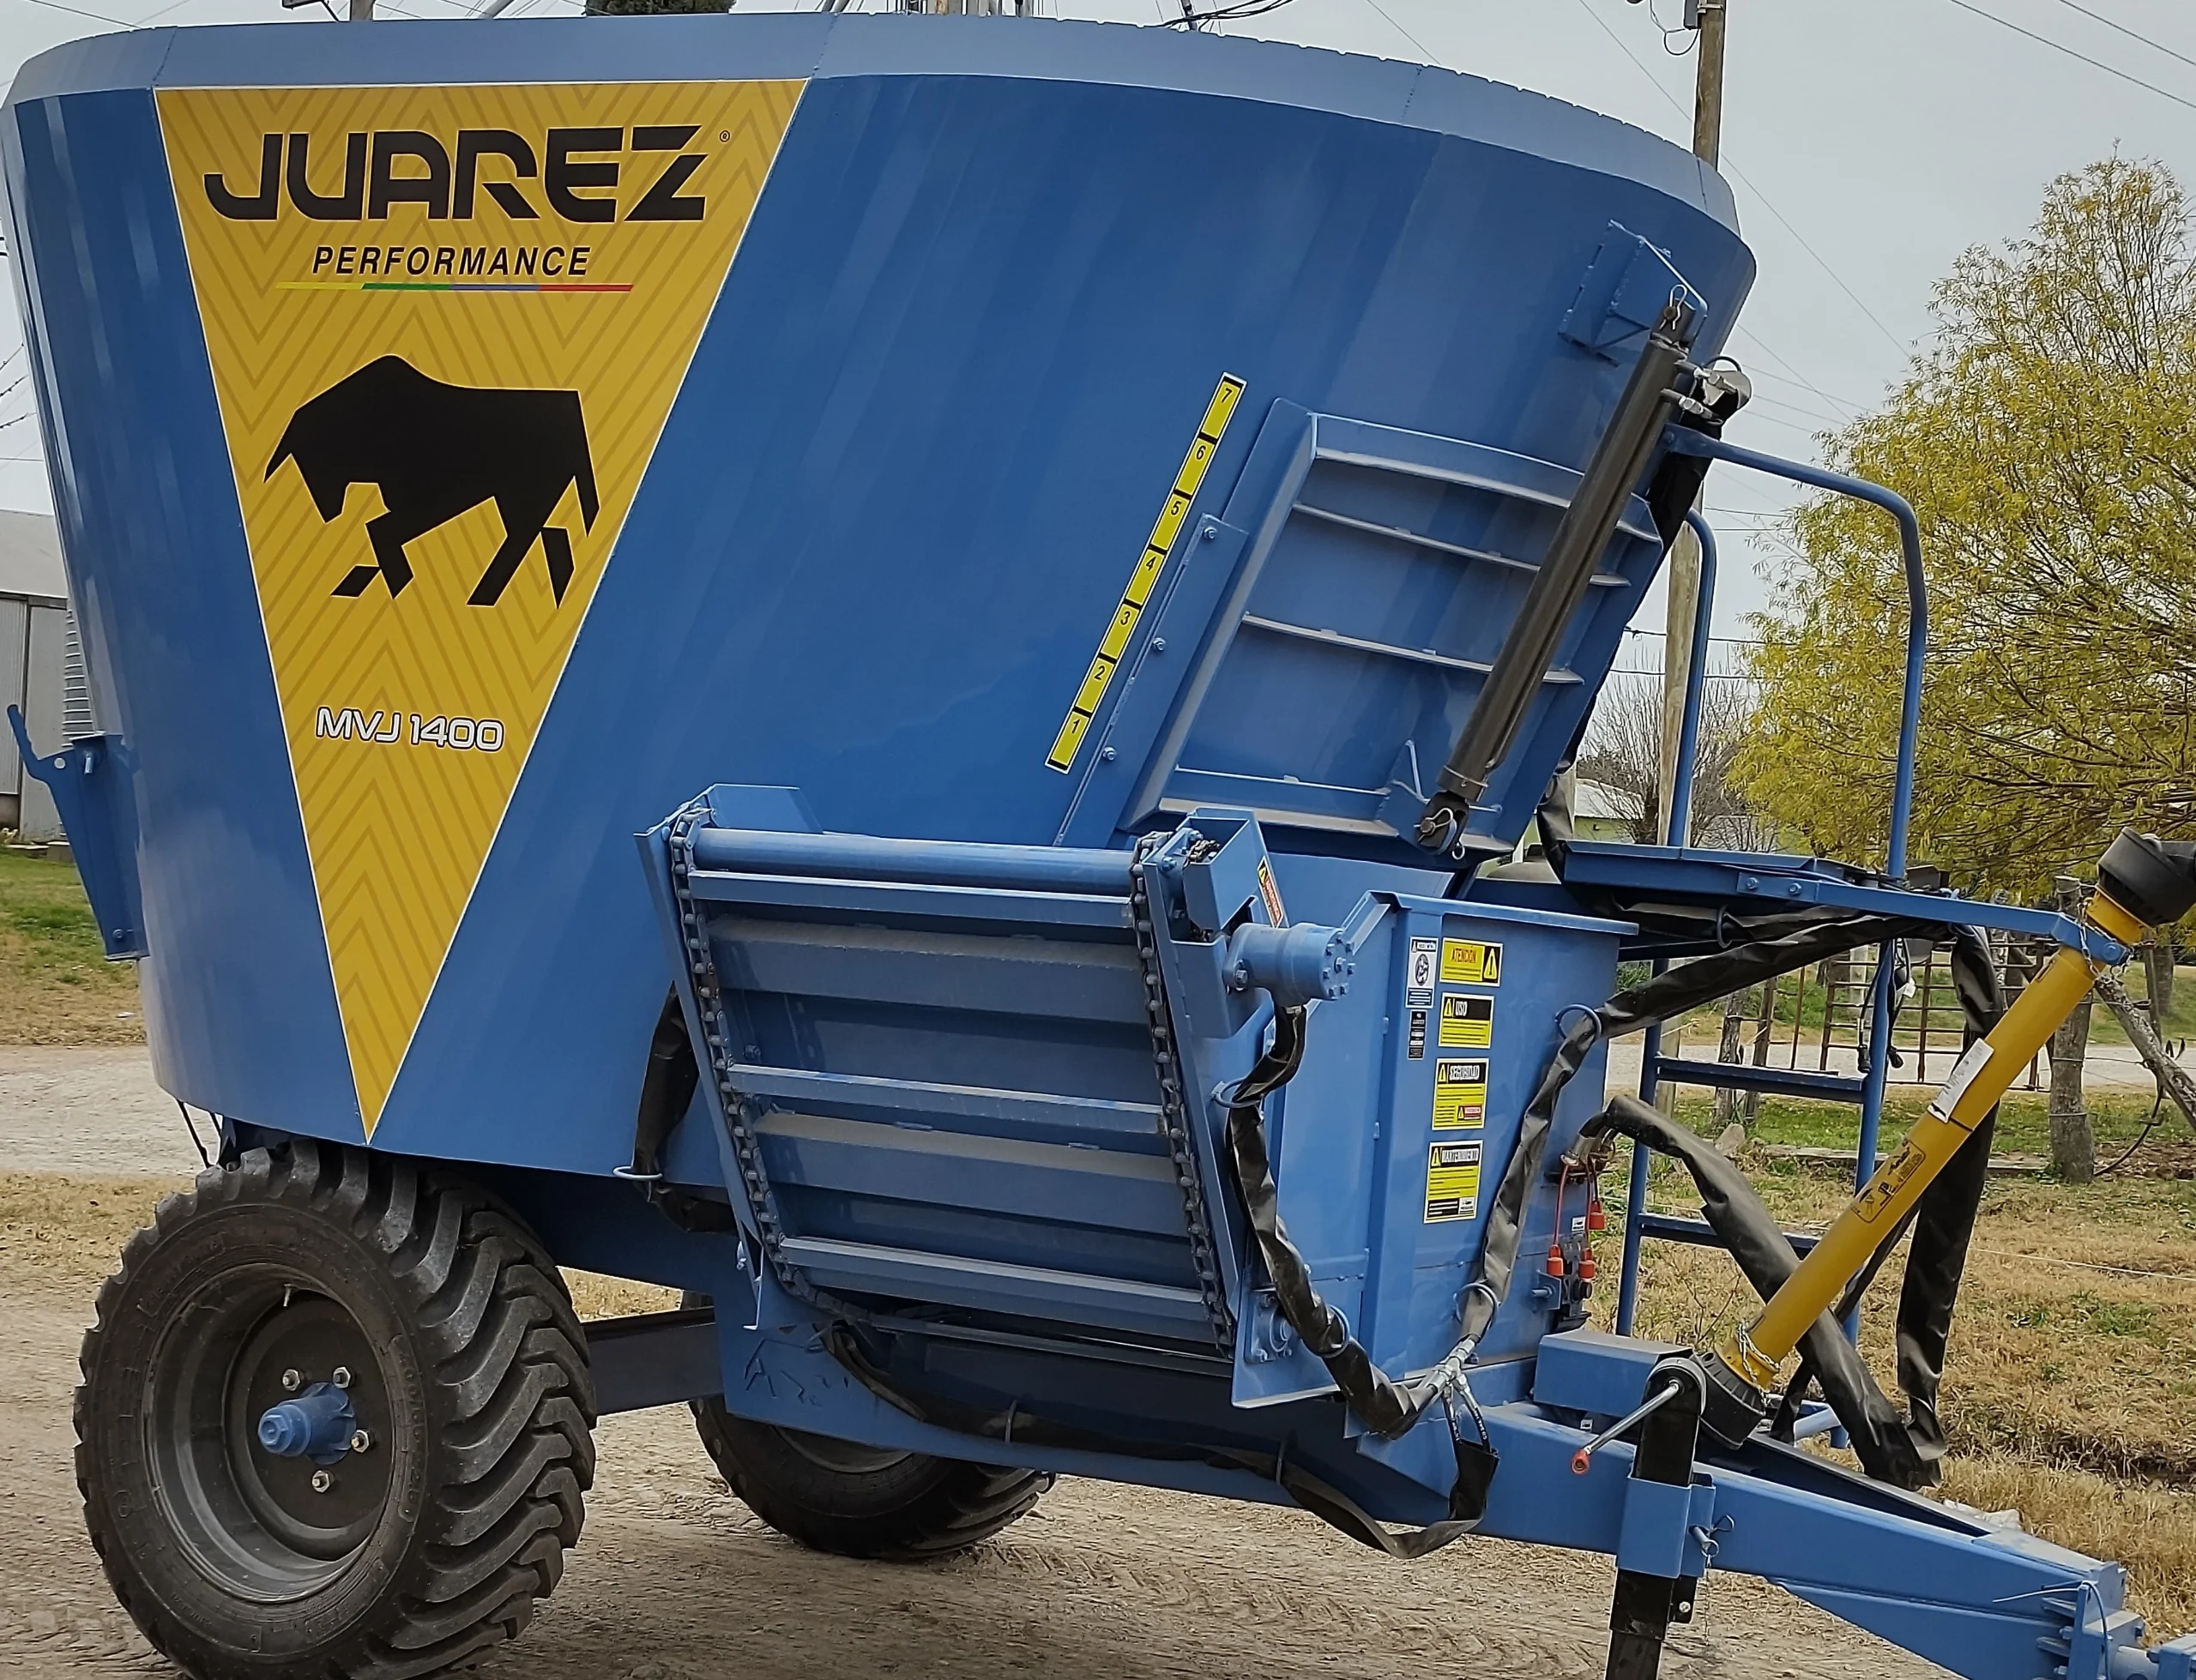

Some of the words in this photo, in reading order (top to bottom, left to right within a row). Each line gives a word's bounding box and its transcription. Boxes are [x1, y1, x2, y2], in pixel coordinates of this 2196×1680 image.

[203, 123, 709, 223] JUAREZ
[312, 245, 592, 277] PERFORMANCE
[1220, 387, 1233, 403] 7
[1196, 445, 1207, 461] 6
[1170, 500, 1182, 516] 5
[1146, 556, 1157, 571] 4
[1119, 611, 1131, 626] 3
[1094, 665, 1106, 681] 2
[316, 706, 401, 743] MVJ
[410, 714, 504, 752] 1400
[1071, 719, 1081, 734] 1
